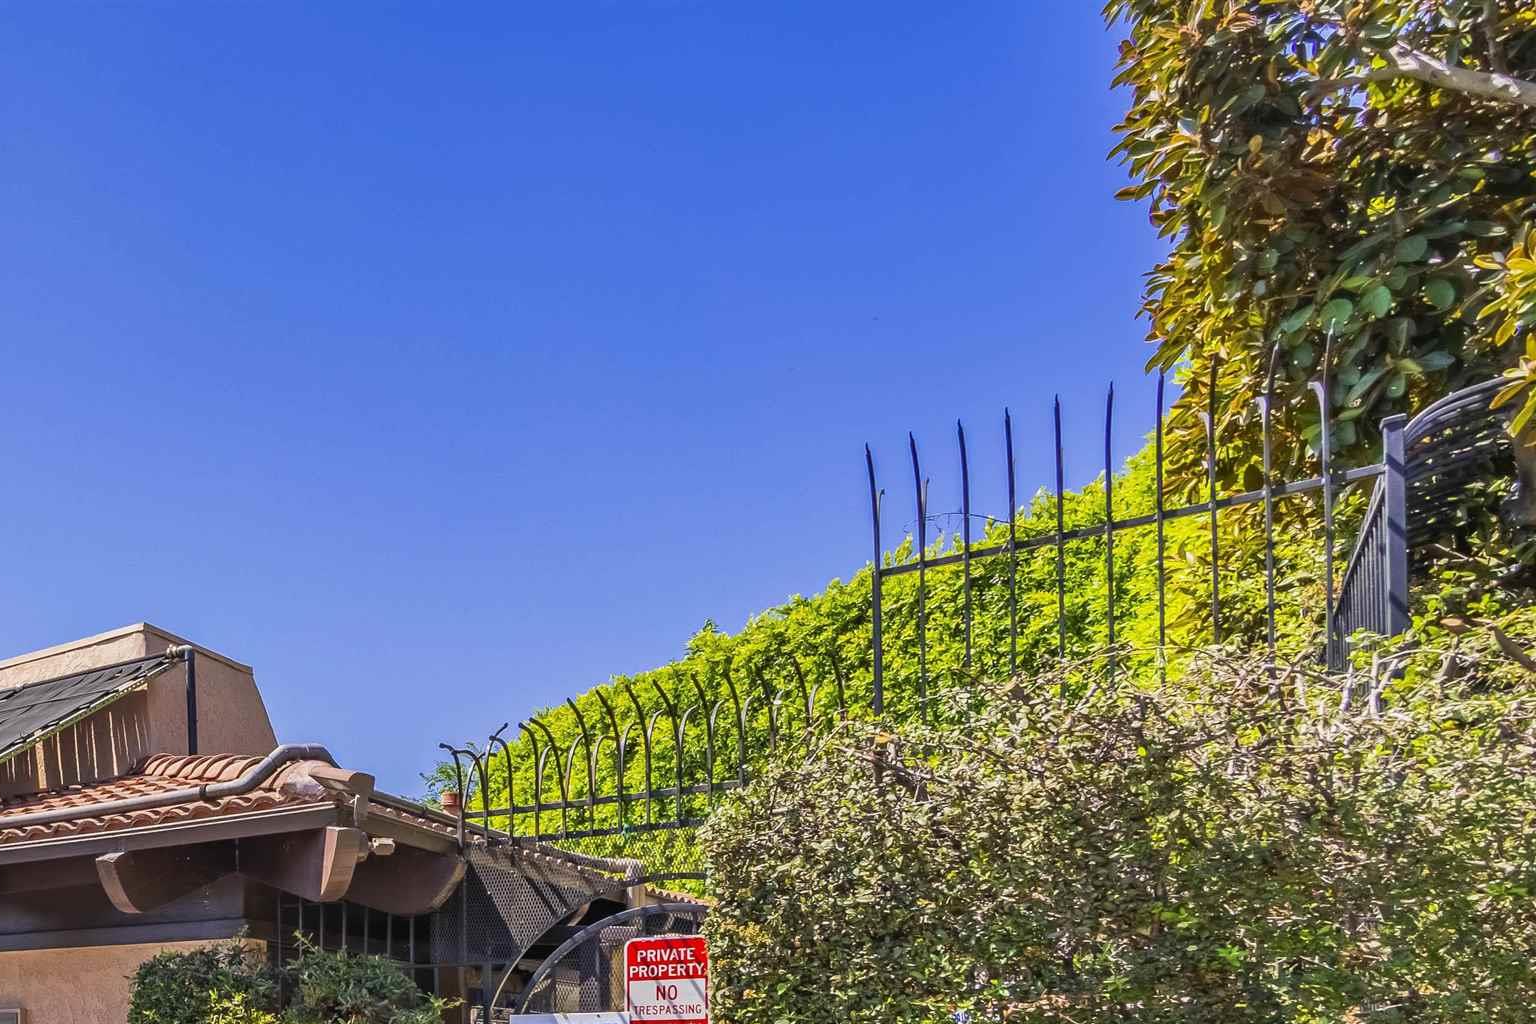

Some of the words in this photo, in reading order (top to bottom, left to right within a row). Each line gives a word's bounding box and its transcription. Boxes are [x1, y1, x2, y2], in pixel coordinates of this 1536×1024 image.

[637, 948, 695, 962] PRIVATE
[630, 963, 704, 977] PROPERTY
[656, 985, 677, 1000] NO
[633, 1004, 702, 1015] TRESPASSING
